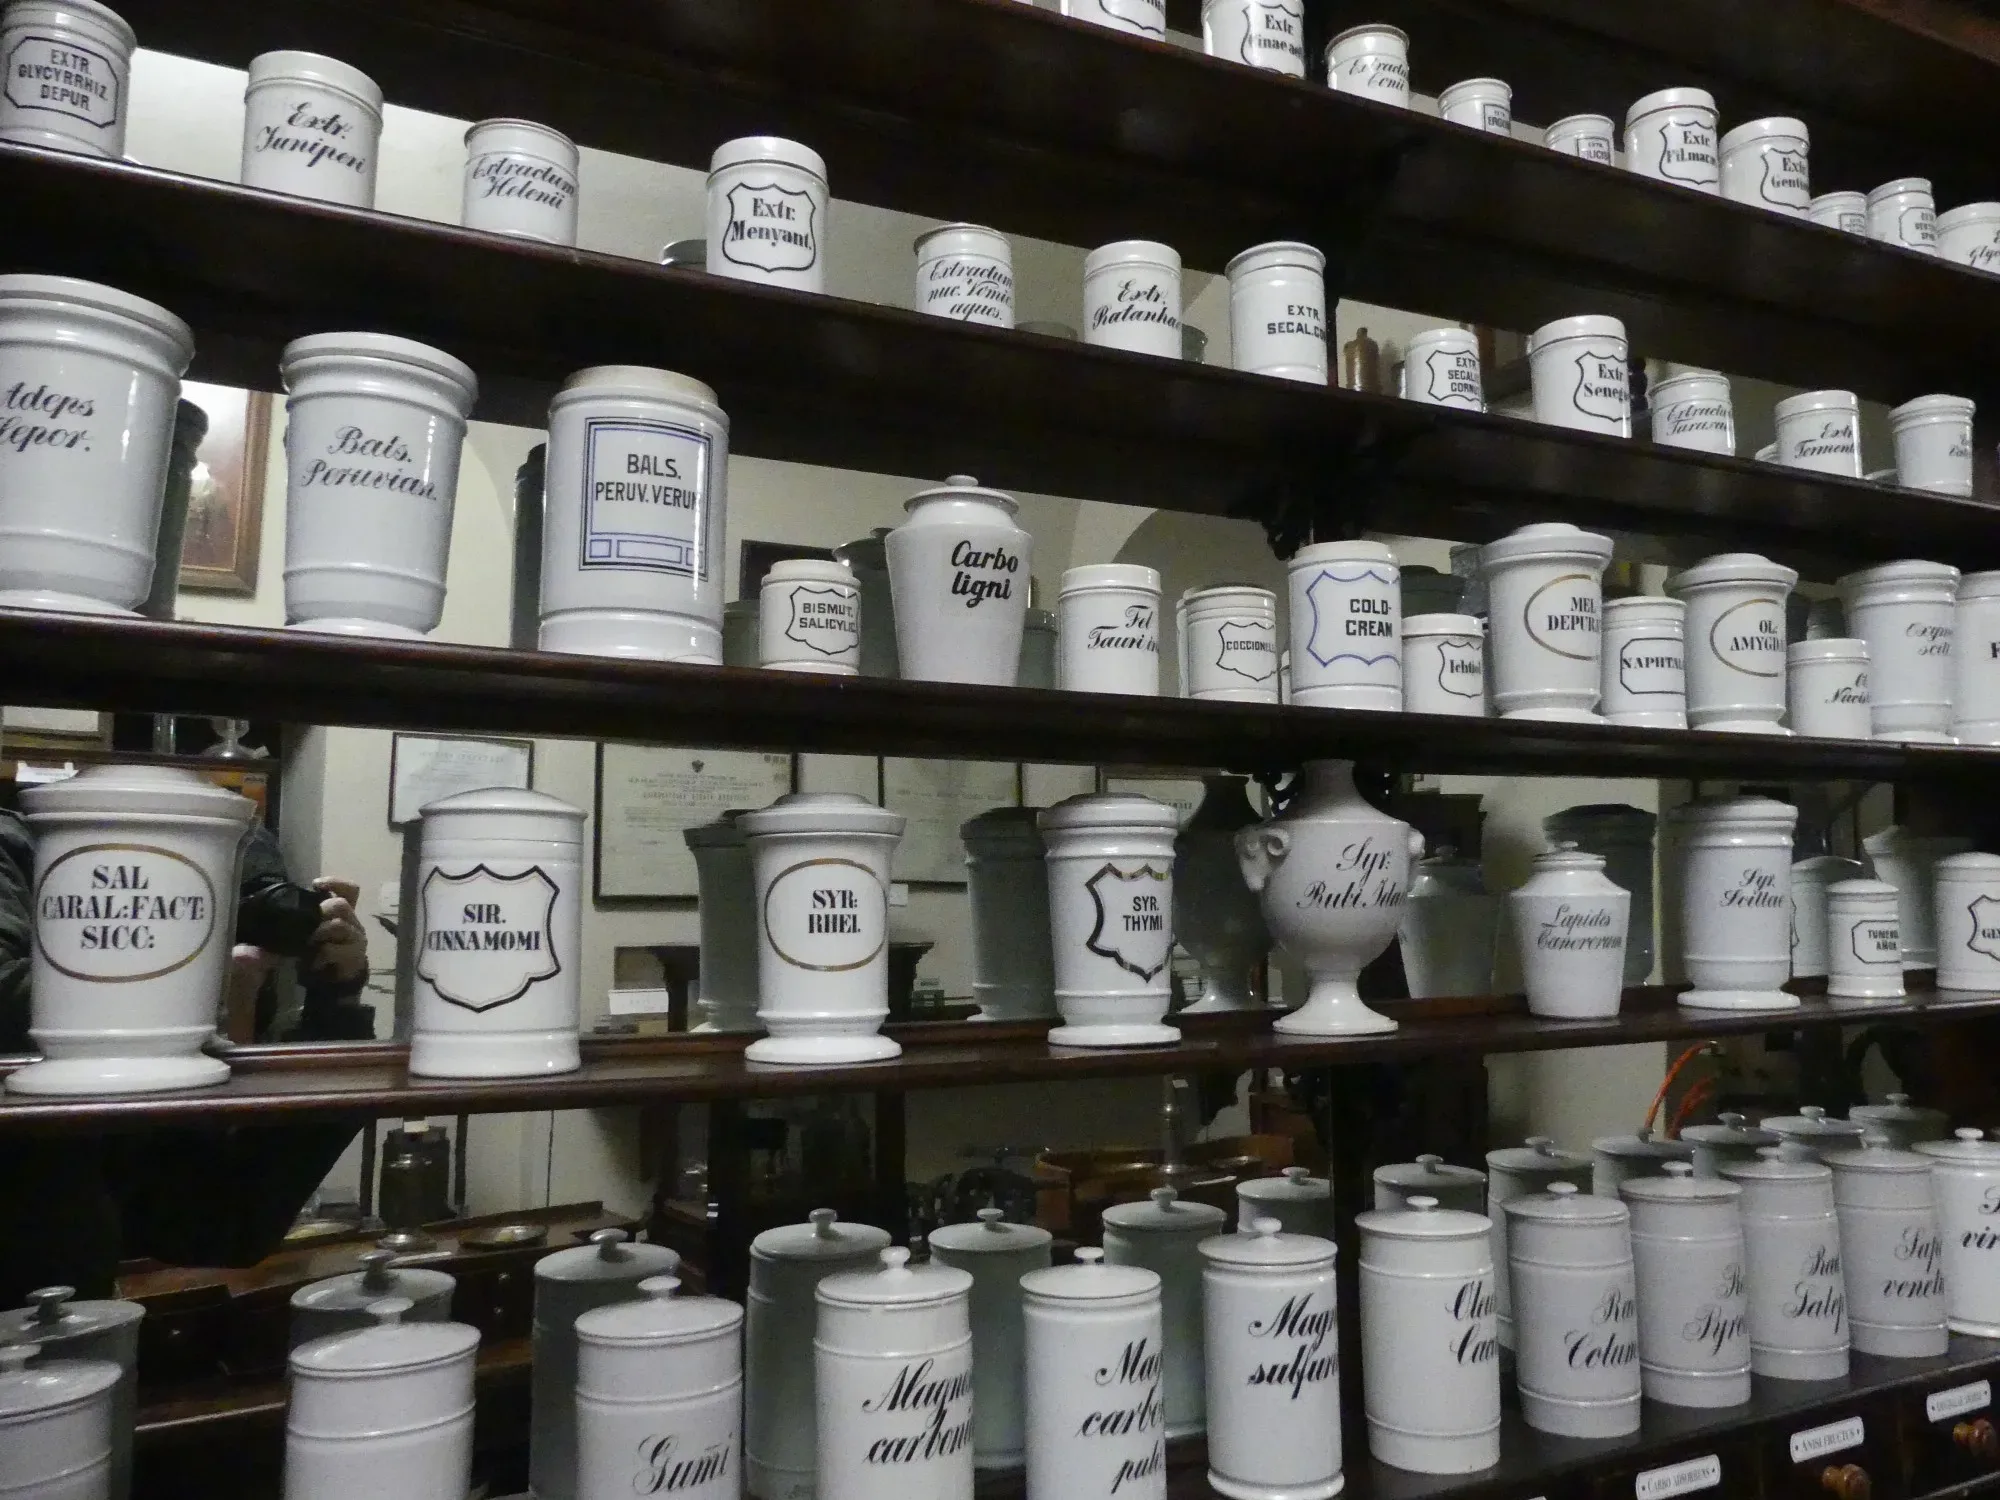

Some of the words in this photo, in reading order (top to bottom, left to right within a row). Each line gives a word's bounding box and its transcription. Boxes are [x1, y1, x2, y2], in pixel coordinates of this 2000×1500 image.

[286, 101, 347, 140] Extr.
[627, 453, 682, 481] BALS.
[951, 539, 1019, 574] Carbo
[951, 571, 1012, 608] ligni
[1571, 597, 1597, 613] MEL
[92, 864, 149, 890] SAL
[463, 903, 507, 924] SIR.
[1132, 896, 1160, 912] SYR.
[1122, 914, 1163, 931] THYMI
[80, 924, 155, 951] SICC:
